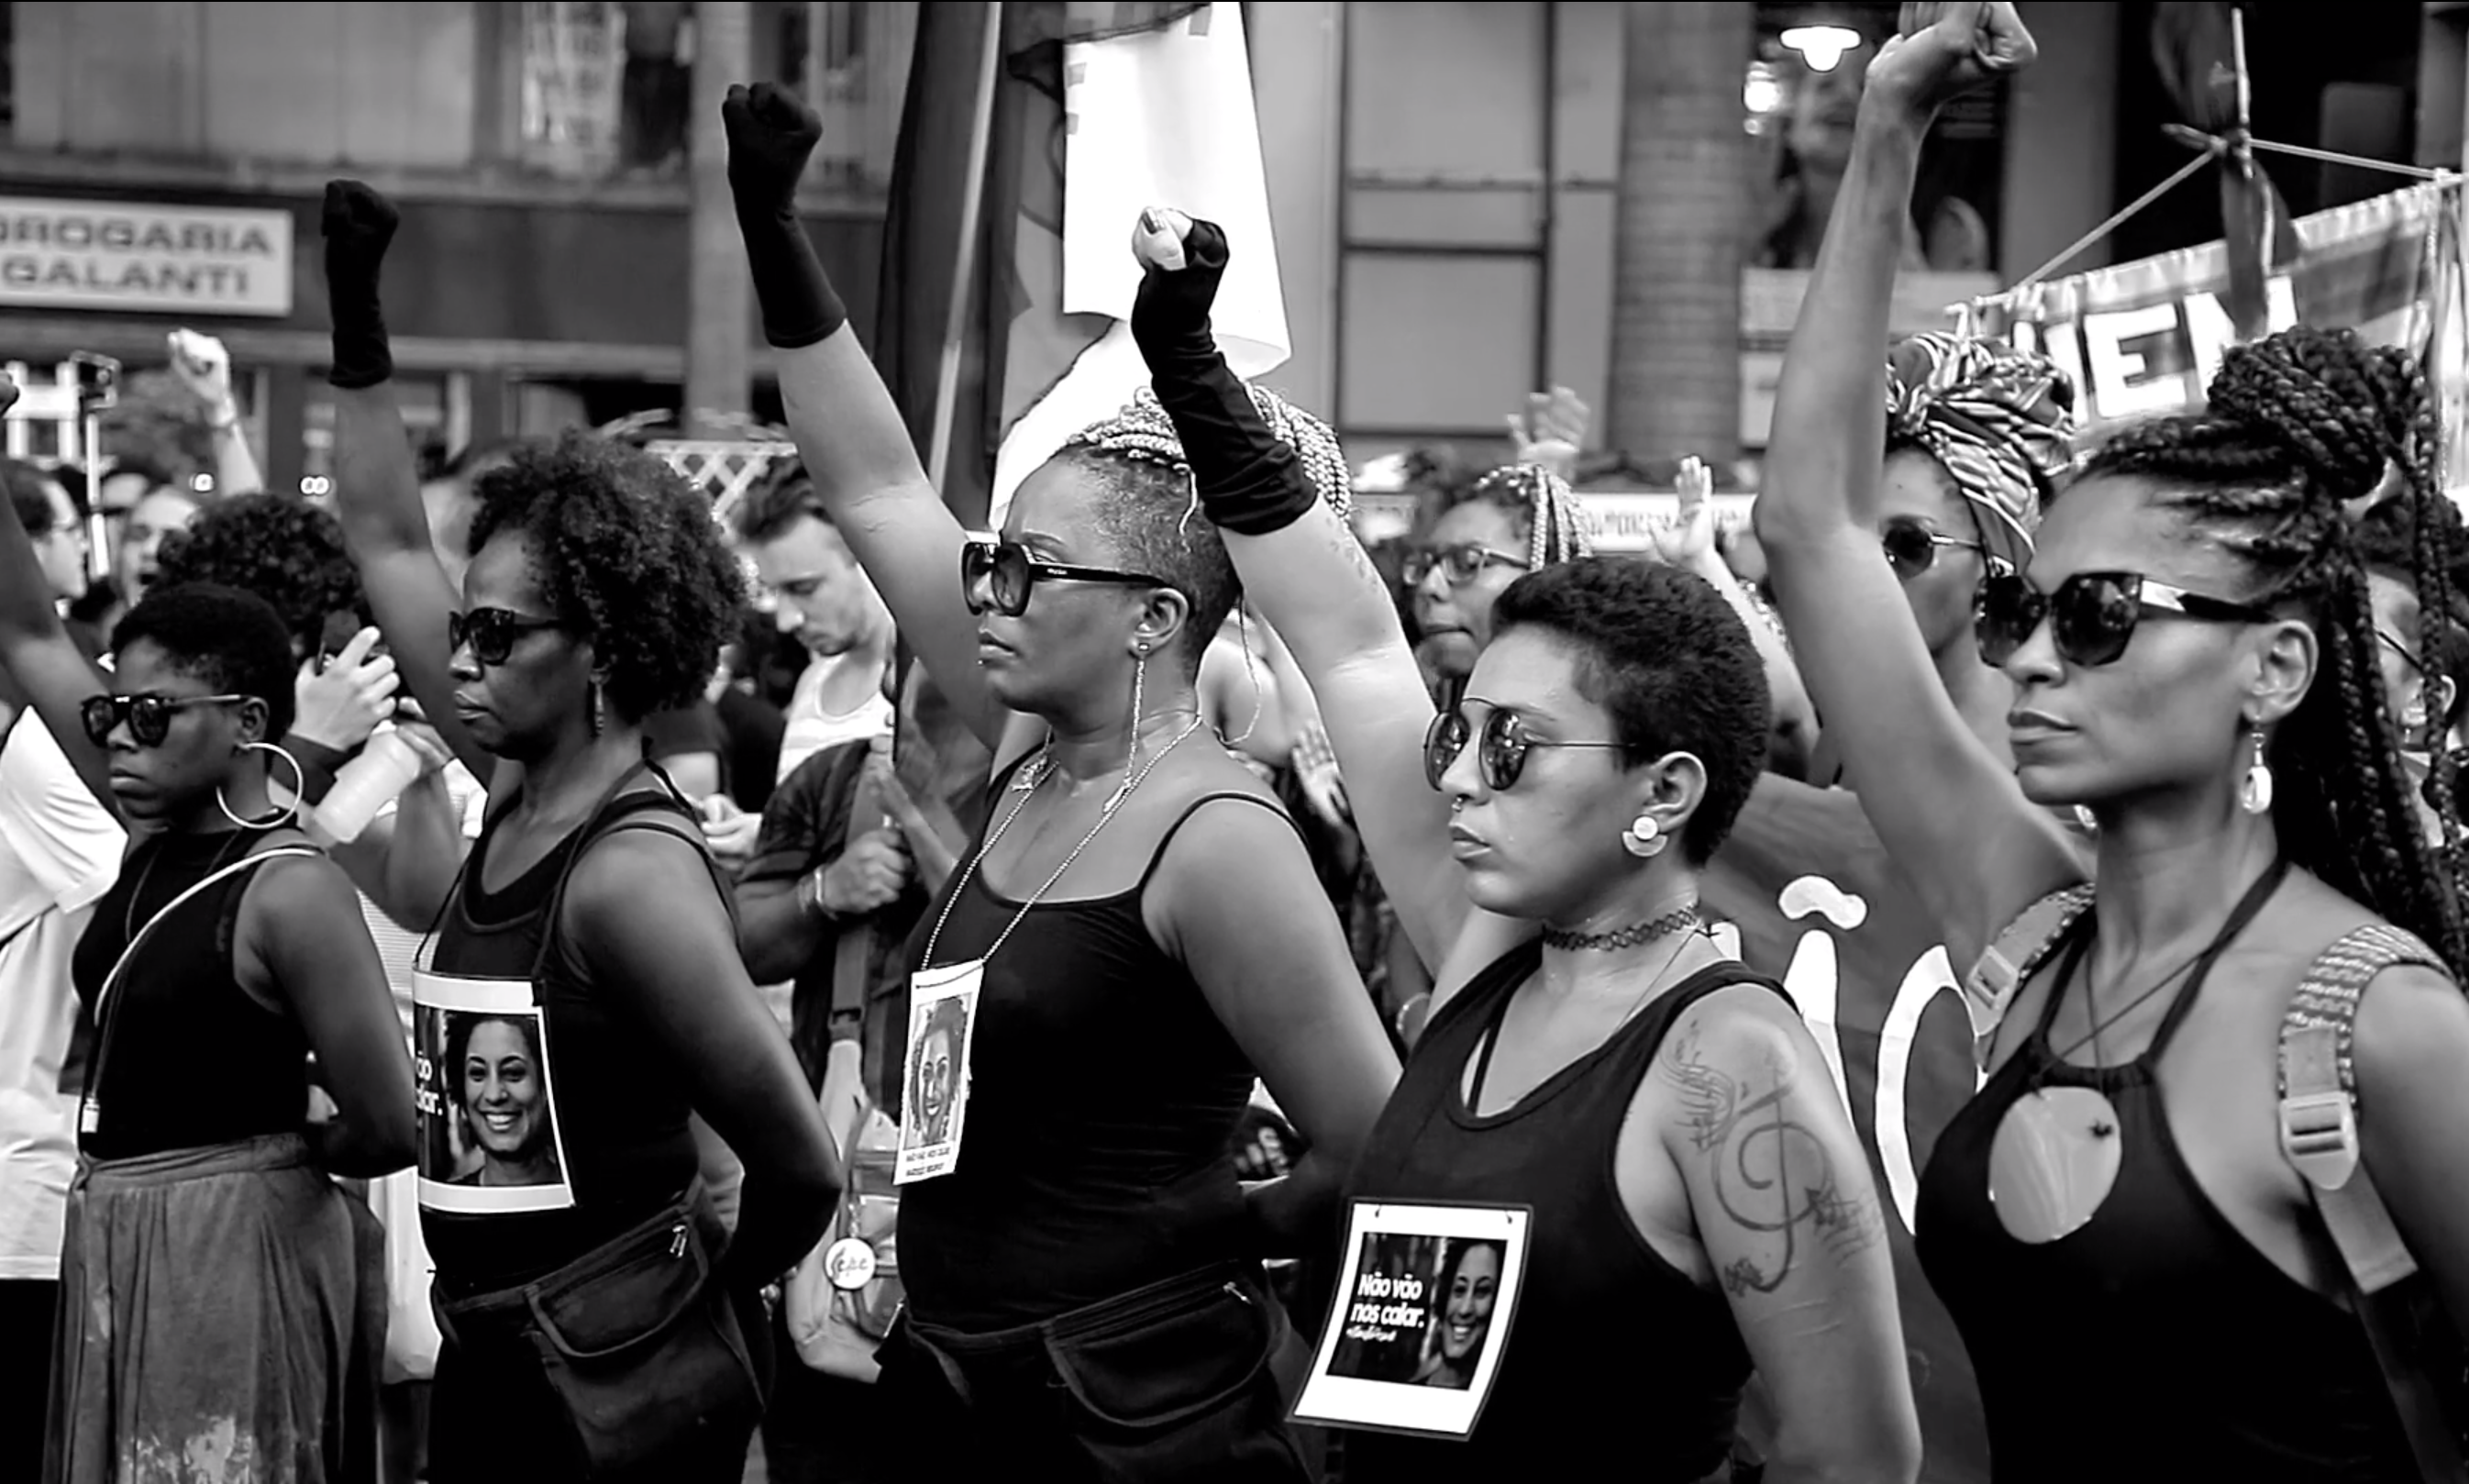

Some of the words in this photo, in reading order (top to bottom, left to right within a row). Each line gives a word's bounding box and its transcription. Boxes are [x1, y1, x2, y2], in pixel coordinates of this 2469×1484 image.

[0, 216, 272, 254] ROGARIA
[3, 255, 249, 293] GALANTI
[1357, 1271, 1391, 1298] Não
[1392, 1273, 1423, 1301] vão
[1350, 1302, 1381, 1323] nos
[1380, 1301, 1424, 1329] calar.
